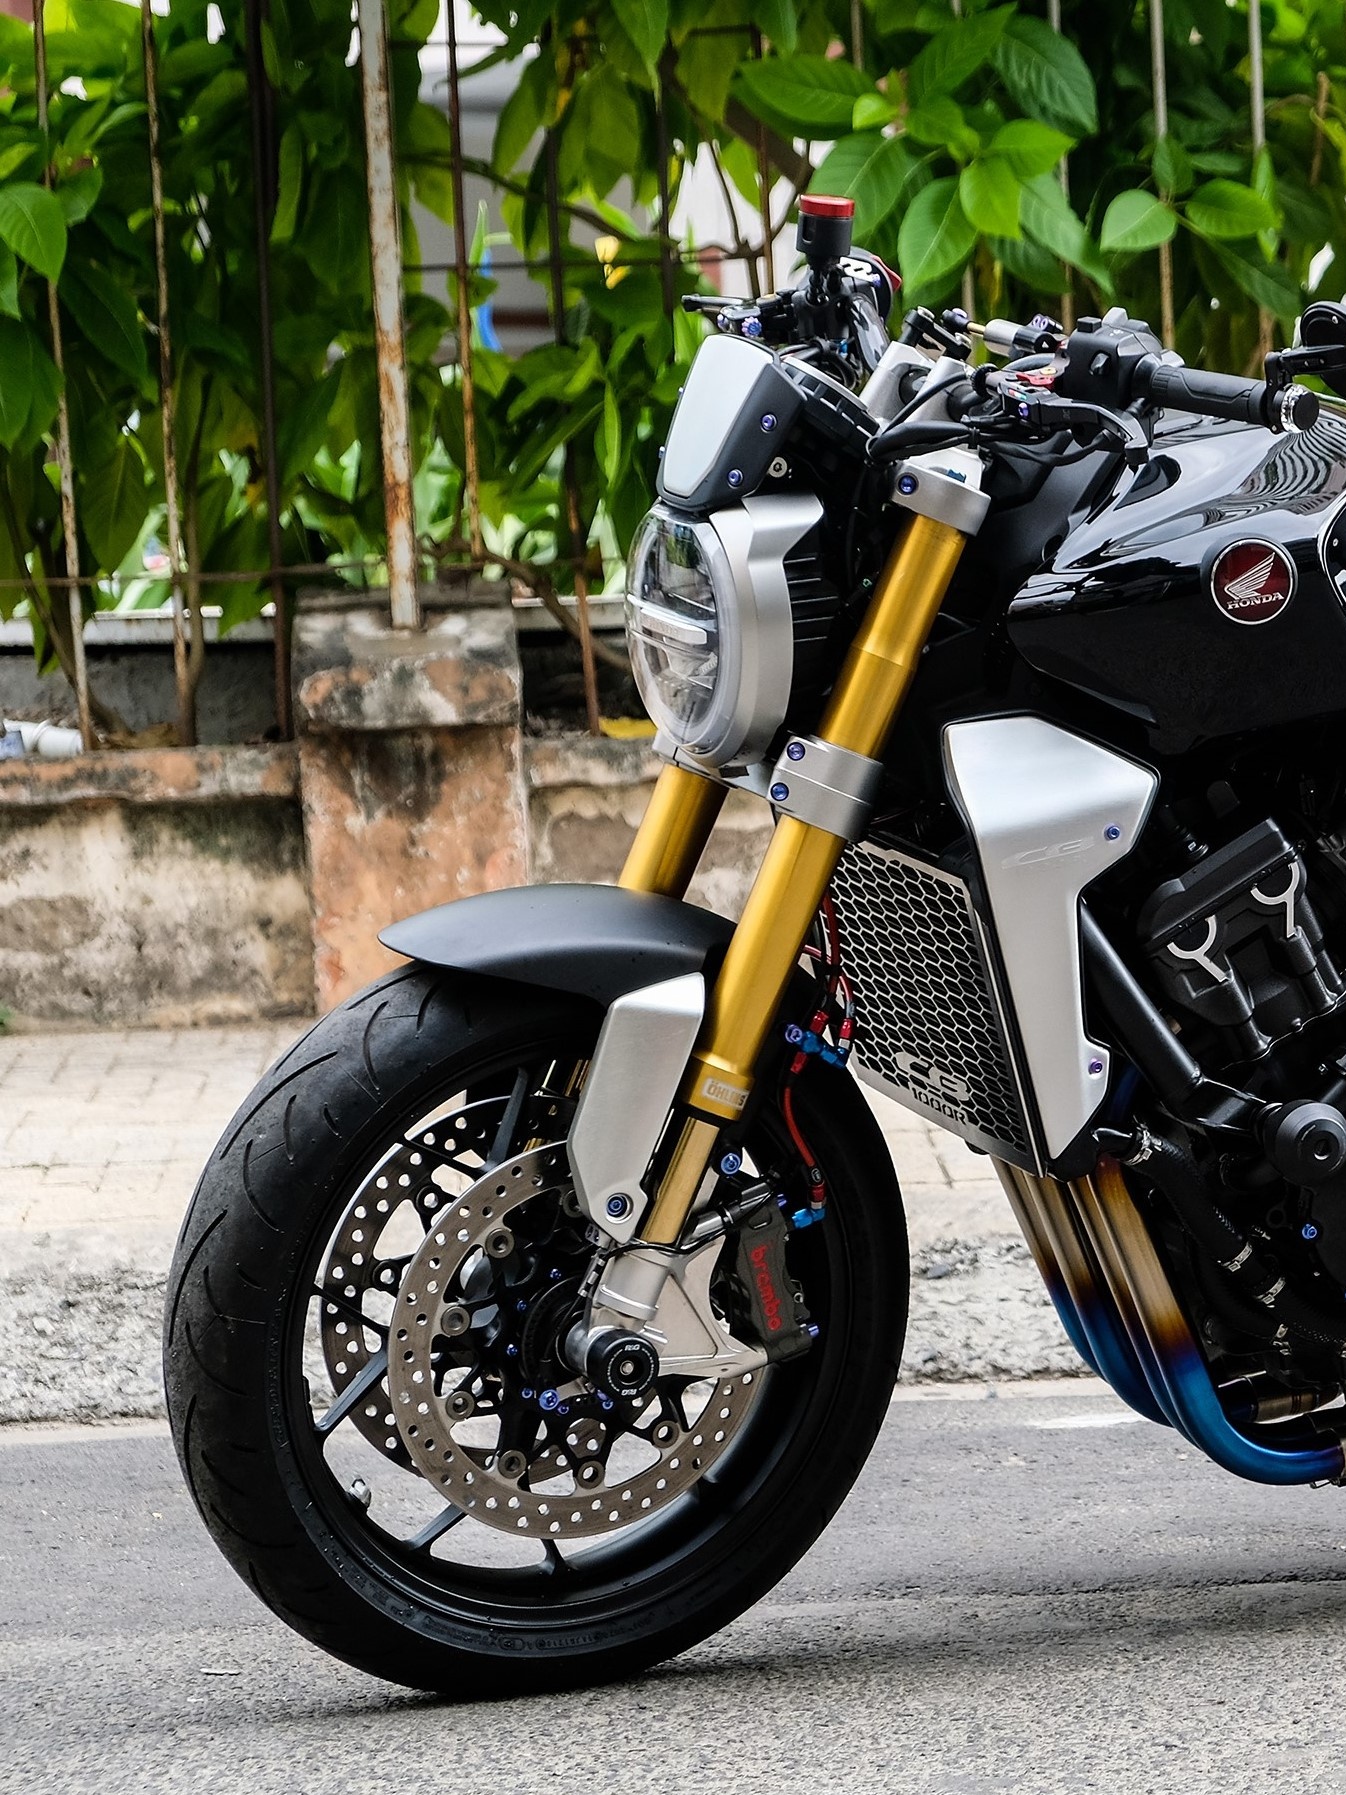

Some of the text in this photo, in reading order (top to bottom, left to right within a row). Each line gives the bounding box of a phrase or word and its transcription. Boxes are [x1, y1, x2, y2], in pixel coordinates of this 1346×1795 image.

[1226, 592, 1285, 610] HONDA
[911, 1086, 967, 1126] 1000R
[751, 1242, 783, 1332] brembo
